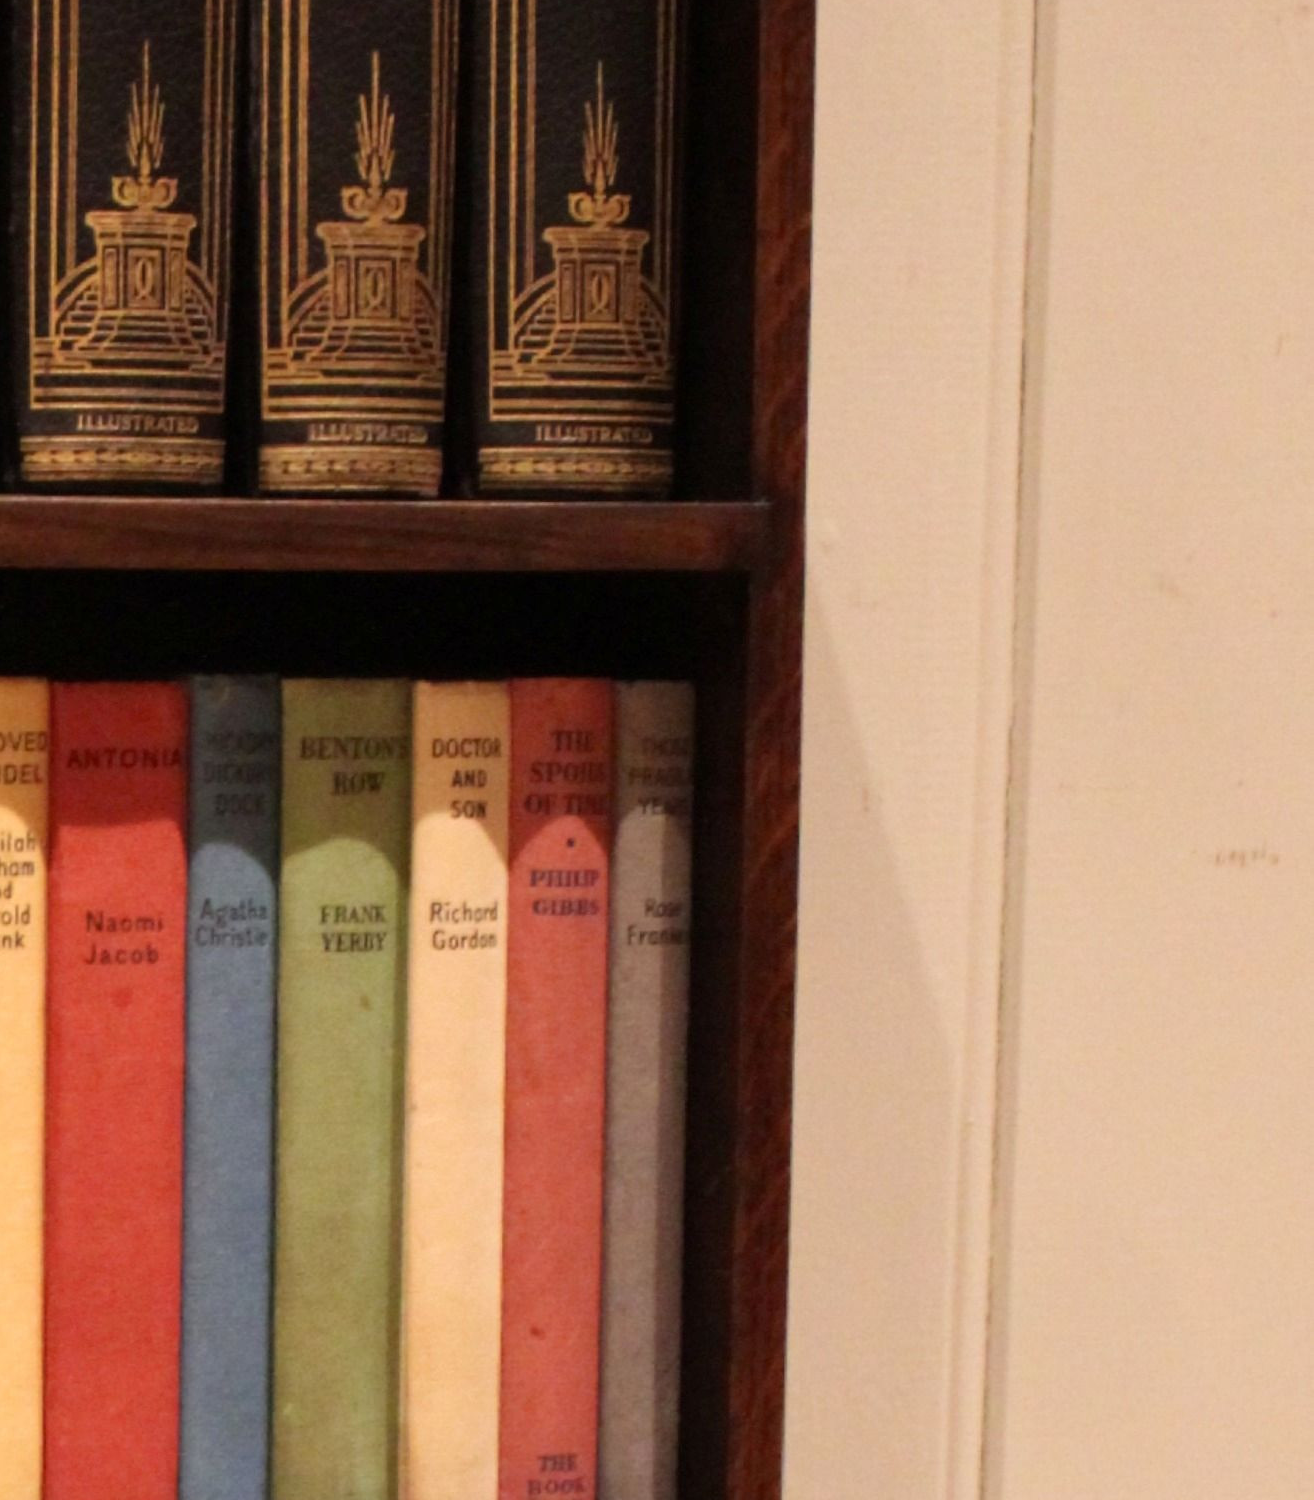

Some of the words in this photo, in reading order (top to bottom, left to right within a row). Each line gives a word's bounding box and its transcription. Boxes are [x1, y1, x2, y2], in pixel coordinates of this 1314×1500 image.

[75, 412, 199, 434] ILLUSTRATED
[308, 422, 429, 445] ILLUSTRATED
[535, 422, 653, 445] ILLUSTRATED
[432, 737, 501, 758] DOCTOR
[66, 748, 180, 769] ANTONIA
[451, 769, 487, 788] AND
[450, 799, 487, 818] SON
[529, 869, 600, 887] PHILIP
[86, 911, 163, 934] Naomi
[200, 898, 268, 929] Agatha
[320, 905, 386, 925] FRANK
[429, 901, 498, 923] Richard
[322, 931, 388, 951] YERBY
[432, 930, 497, 950] Gordon
[84, 945, 159, 966] Jacob
[538, 1453, 578, 1472] THE
[527, 1477, 584, 1495] BOOK
